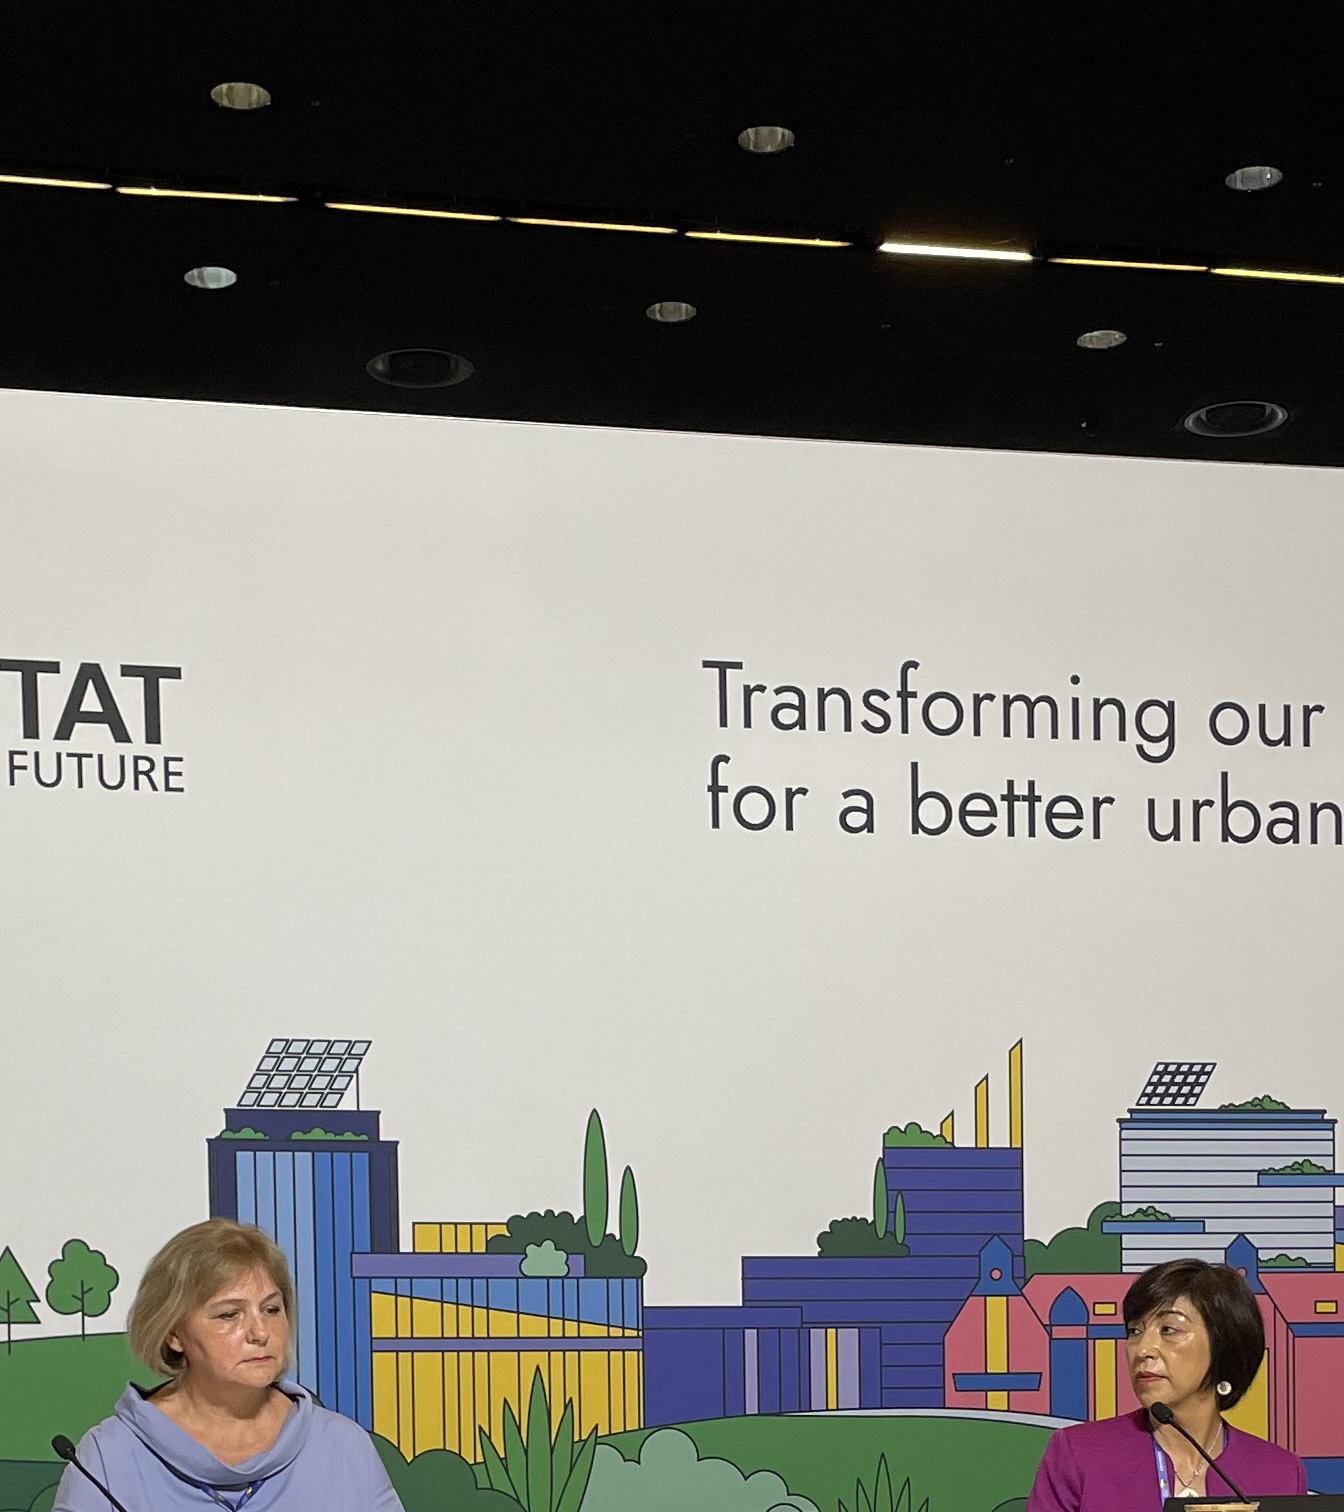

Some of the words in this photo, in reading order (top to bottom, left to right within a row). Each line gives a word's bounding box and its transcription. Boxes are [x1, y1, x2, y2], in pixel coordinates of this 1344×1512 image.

[701, 659, 1176, 764] Transforming
[1208, 701, 1326, 748] our
[8, 749, 185, 793] FUTURE
[706, 754, 809, 832] for
[838, 788, 875, 834] a
[910, 761, 1116, 840] better
[1147, 770, 1343, 846] urban
